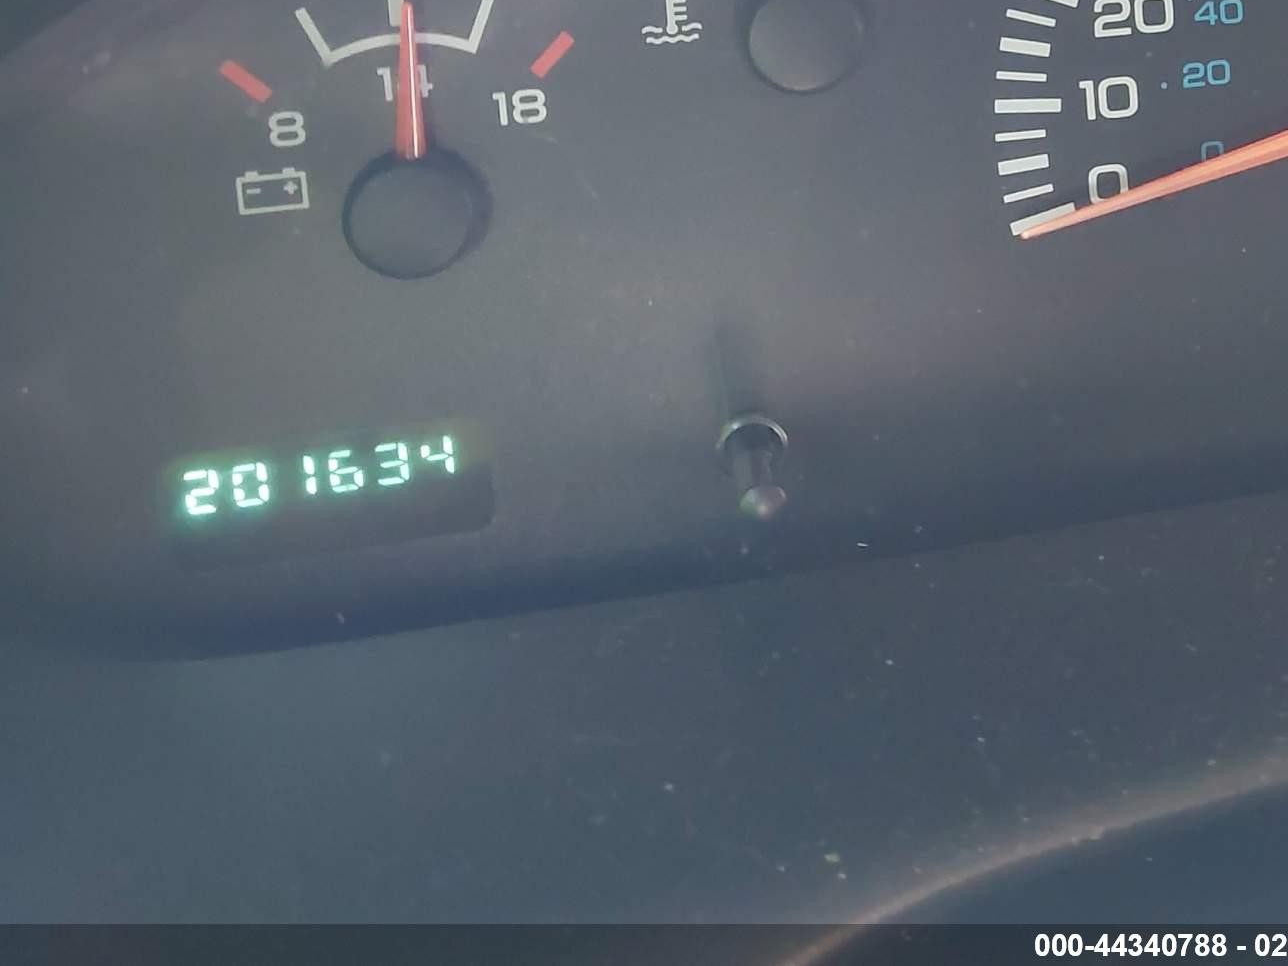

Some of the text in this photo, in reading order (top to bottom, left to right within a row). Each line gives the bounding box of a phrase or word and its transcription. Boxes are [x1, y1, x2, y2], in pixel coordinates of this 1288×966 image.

[1182, 59, 1231, 89] 20
[492, 88, 547, 126] 18
[1078, 76, 1139, 121] 10
[268, 111, 306, 147] 8
[183, 435, 456, 516] 201634
